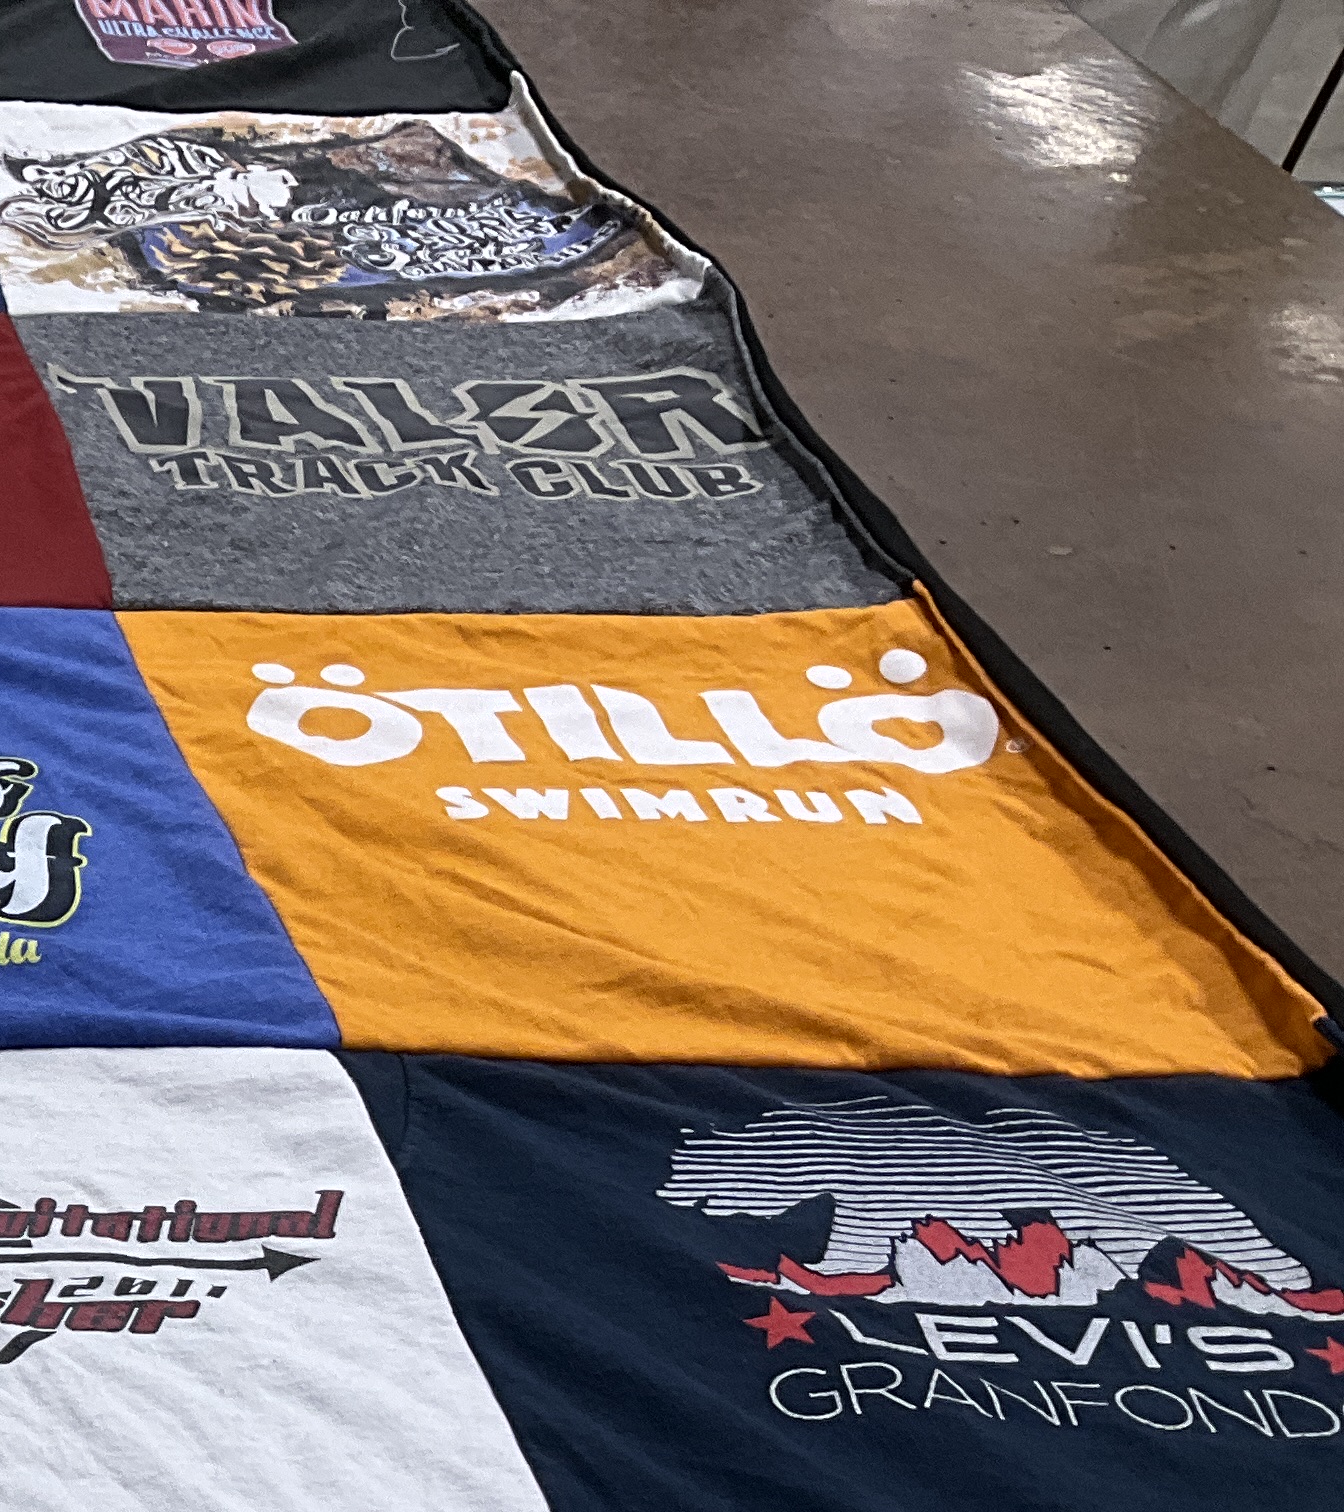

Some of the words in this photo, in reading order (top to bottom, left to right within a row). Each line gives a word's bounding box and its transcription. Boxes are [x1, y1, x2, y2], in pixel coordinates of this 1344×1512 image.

[98, 19, 161, 37] ULTRA
[153, 450, 500, 500] TRACK
[509, 456, 764, 501] CLUB
[246, 648, 1000, 774] ÖTILLÖ
[434, 785, 923, 826] SWIMRUN
[828, 1307, 1295, 1373] LEVI'S
[769, 1361, 1344, 1440] GRANFOND
